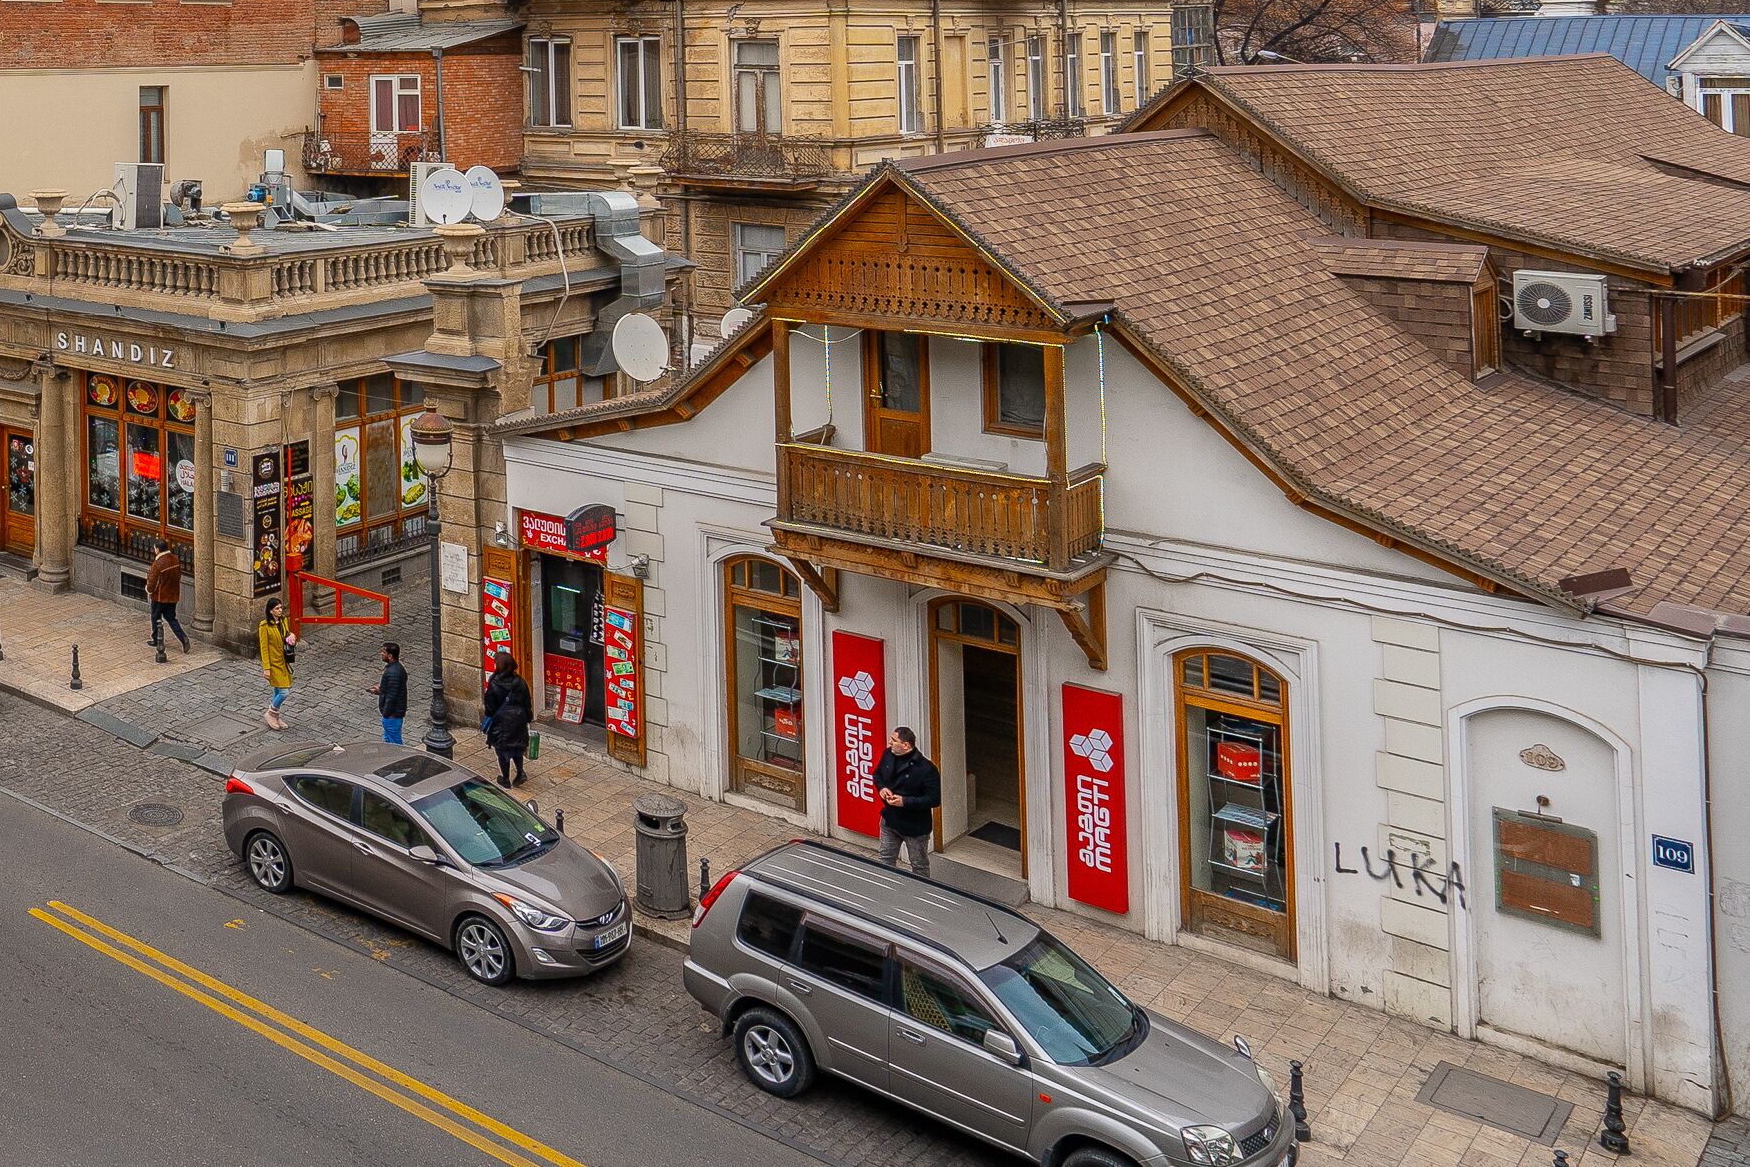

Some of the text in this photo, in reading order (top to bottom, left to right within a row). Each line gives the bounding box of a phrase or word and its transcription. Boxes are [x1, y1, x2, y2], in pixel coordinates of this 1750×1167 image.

[58, 332, 174, 368] SHANDIZ
[1657, 844, 1689, 864] 109
[1334, 841, 1467, 911] LUKA
